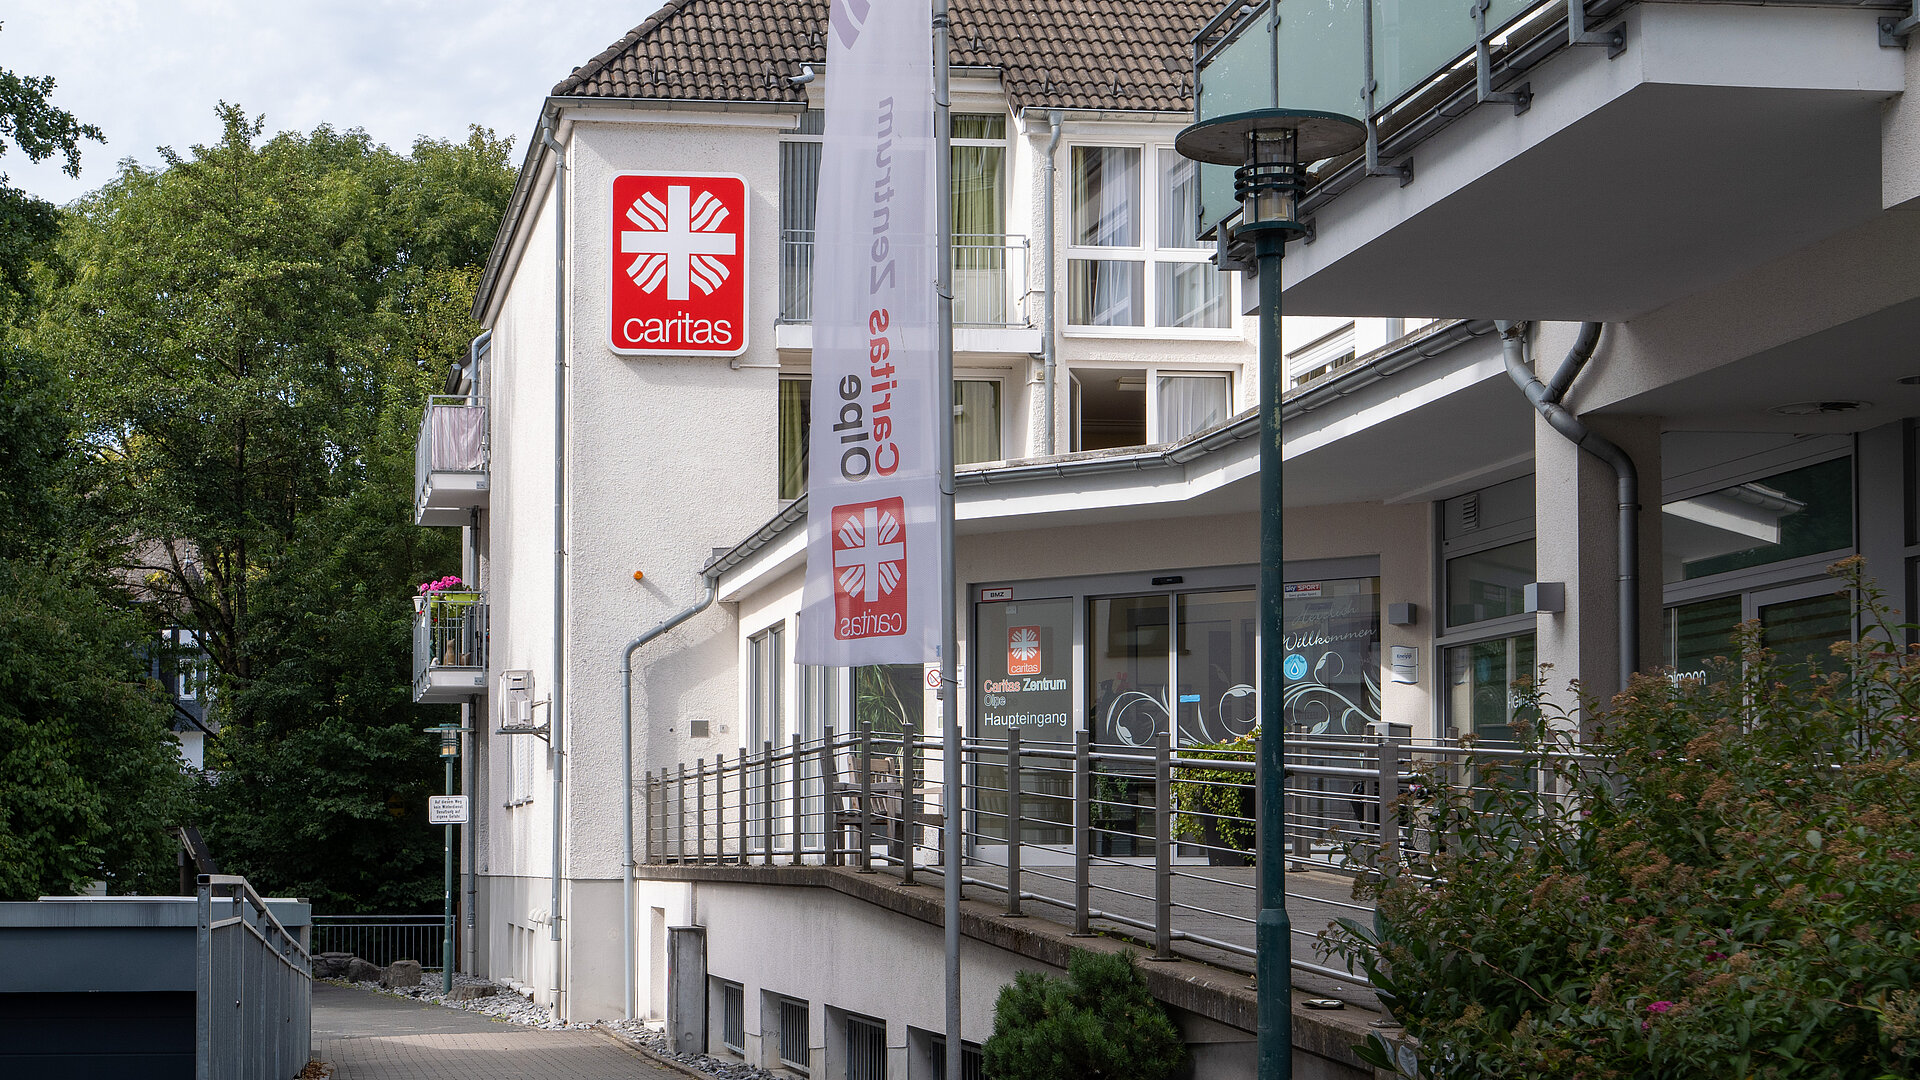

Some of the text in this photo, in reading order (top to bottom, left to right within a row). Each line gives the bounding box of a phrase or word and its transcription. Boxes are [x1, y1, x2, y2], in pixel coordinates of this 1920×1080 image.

[623, 311, 732, 345] caritas
[1297, 583, 1320, 591] SPORT
[1283, 628, 1376, 651] Willkommen
[1011, 663, 1038, 673] caritas
[984, 677, 1067, 693] Caritas Zentrum
[984, 694, 1006, 708] Olpe
[984, 711, 1067, 727] Haupteingang
